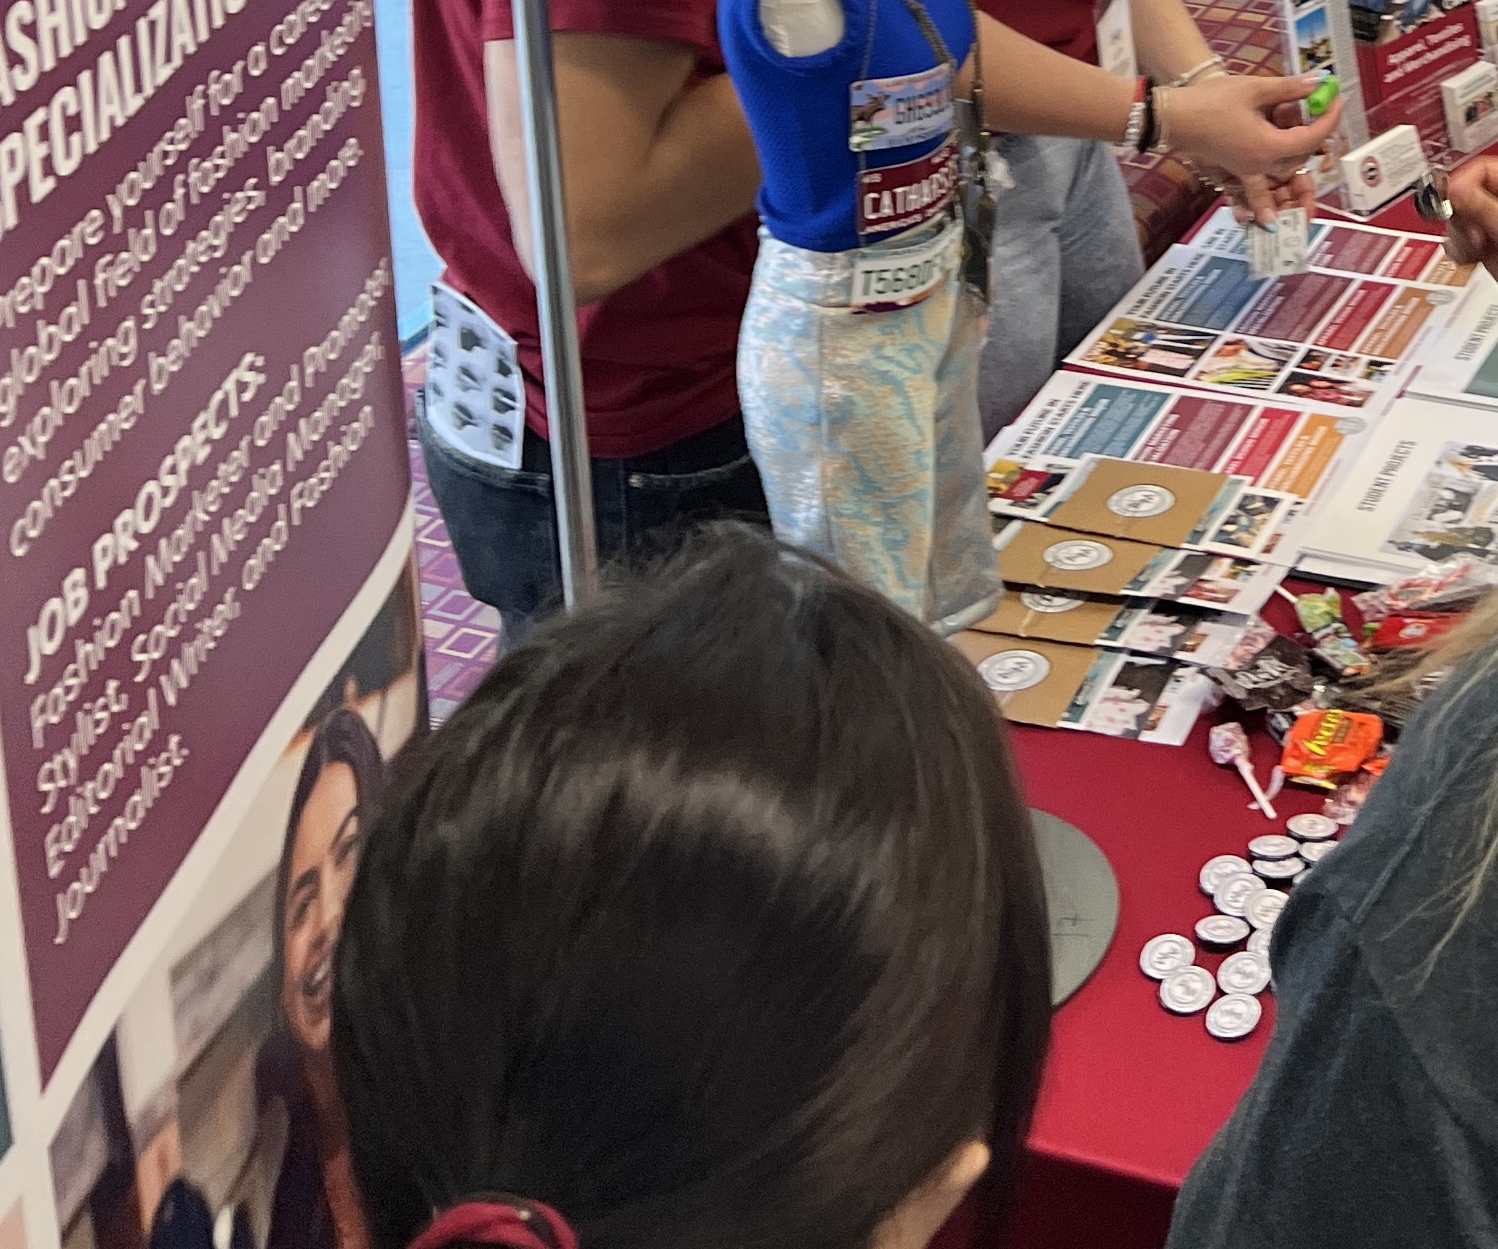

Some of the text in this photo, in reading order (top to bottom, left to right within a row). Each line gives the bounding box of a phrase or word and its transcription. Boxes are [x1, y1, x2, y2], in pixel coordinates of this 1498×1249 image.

[0, 209, 105, 328] repare
[105, 85, 206, 235] yourself
[207, 60, 246, 116] for
[0, 278, 91, 427] global
[94, 210, 157, 308] field
[159, 173, 186, 236] of
[188, 96, 280, 205] fashion
[2, 315, 138, 483] exploring
[10, 378, 146, 557] consumer
[148, 249, 254, 395] behavior
[256, 185, 305, 264] and
[24, 351, 267, 685] JOB PROSPECTS:
[1356, 438, 1418, 513] STUDENT PROJECTS
[30, 589, 141, 749] Fashion
[144, 434, 252, 599] Marketer
[253, 363, 300, 446] and
[44, 686, 160, 879] Editorial
[242, 503, 289, 591] and
[290, 404, 375, 526] Fashion
[131, 551, 208, 683] Social
[210, 459, 284, 576] Media
